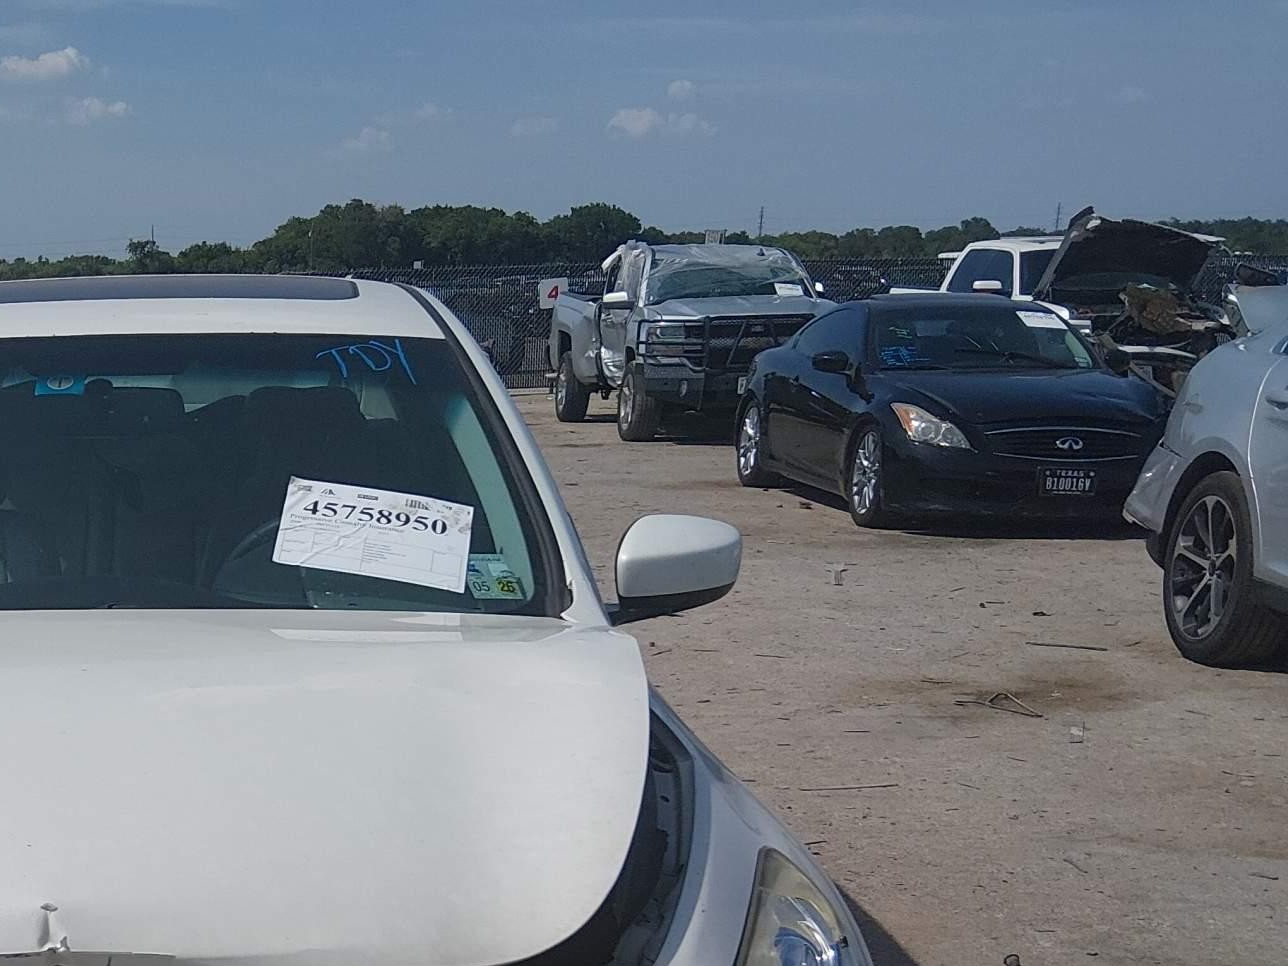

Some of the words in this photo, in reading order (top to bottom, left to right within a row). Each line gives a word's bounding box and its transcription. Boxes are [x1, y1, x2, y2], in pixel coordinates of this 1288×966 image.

[547, 285, 559, 301] 4
[303, 500, 447, 534] 45758950
[473, 581, 490, 592] 05
